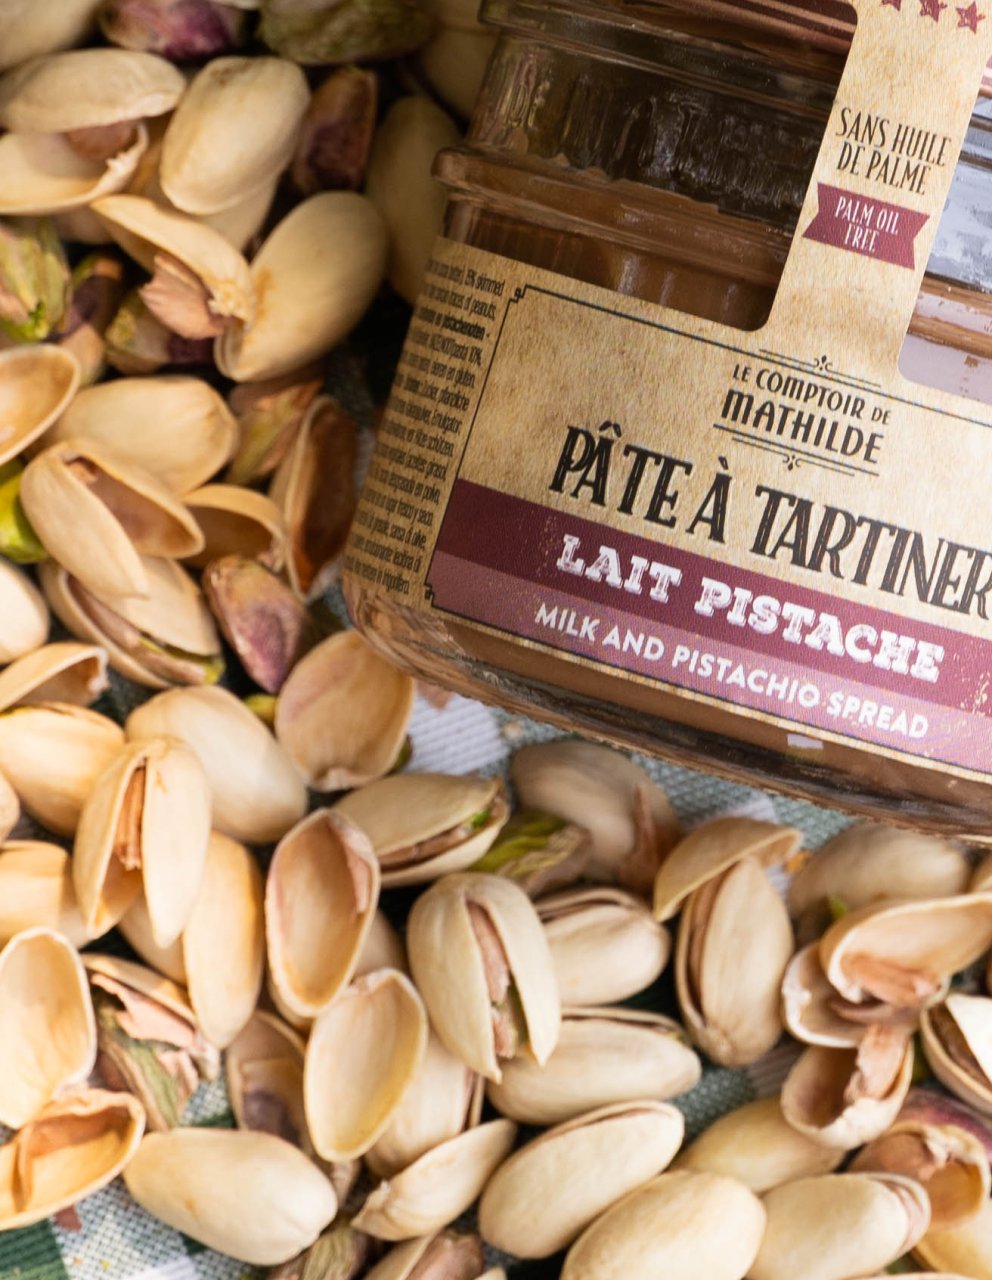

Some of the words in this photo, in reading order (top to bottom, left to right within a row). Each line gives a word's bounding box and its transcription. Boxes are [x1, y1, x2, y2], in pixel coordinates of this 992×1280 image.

[836, 107, 890, 148] SANS
[891, 123, 952, 167] HUILE
[837, 141, 866, 176] DE
[865, 150, 932, 195] PALME
[835, 196, 874, 227] PALM
[876, 209, 899, 235] OIL
[844, 223, 880, 253] FREE
[469, 299, 496, 321] peanuts,
[476, 274, 505, 296] skimmed
[454, 368, 475, 389] gluten.
[733, 364, 752, 382] LE
[756, 368, 866, 420] COMPTOIR
[872, 406, 892, 426] DE
[721, 388, 885, 464] MATHILDE
[548, 421, 693, 528] PÂTE
[686, 456, 734, 543] À
[556, 534, 682, 603] LAIT
[694, 577, 944, 683] PISTACHE
[534, 603, 599, 642] MILK
[602, 624, 664, 661] AND
[672, 644, 820, 708] PISTACHIO
[827, 691, 928, 738] SPREAD
